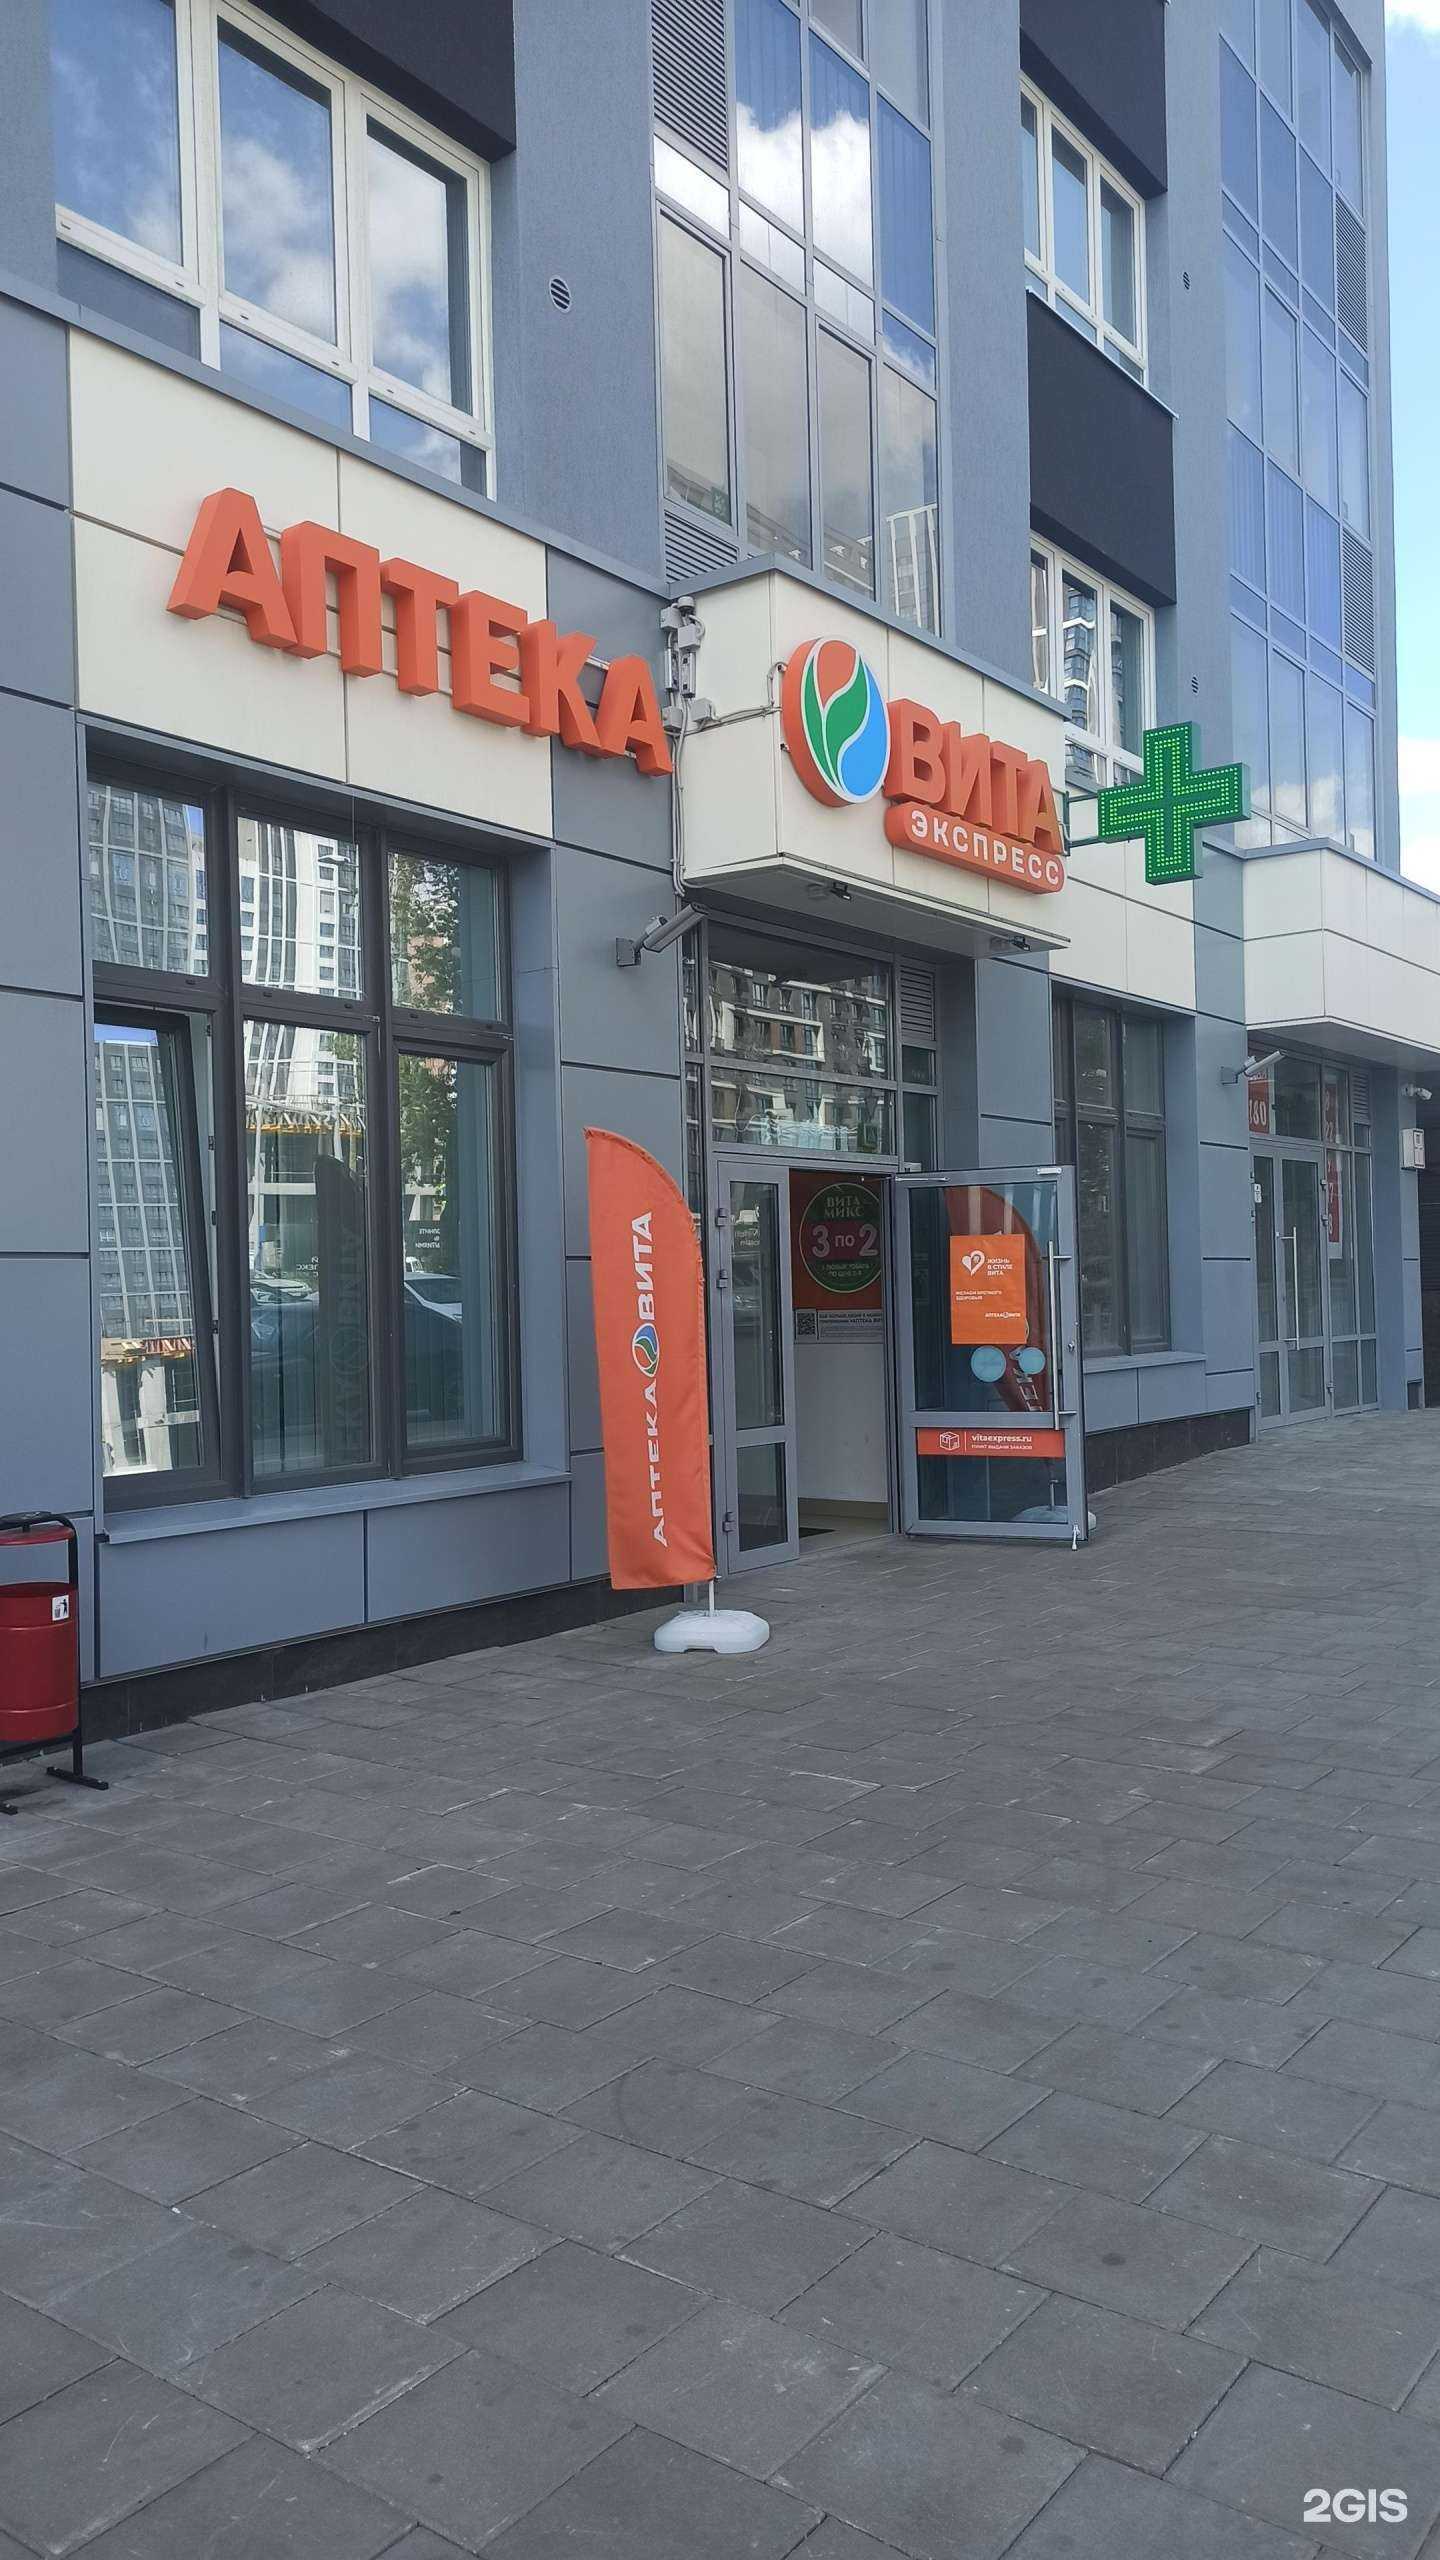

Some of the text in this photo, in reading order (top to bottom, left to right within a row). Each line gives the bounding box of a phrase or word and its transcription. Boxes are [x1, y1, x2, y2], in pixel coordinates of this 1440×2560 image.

[167, 487, 672, 777] АПТЕКА
[883, 698, 1064, 855] ВИТА
[910, 809, 1060, 885] ЭКСПРЕСС
[812, 1225, 831, 1258] 3
[859, 1223, 879, 1257] 2
[631, 1211, 667, 1548] АПТЕКА ВИТА
[971, 1433, 1032, 1444] vitaexpress.ru
